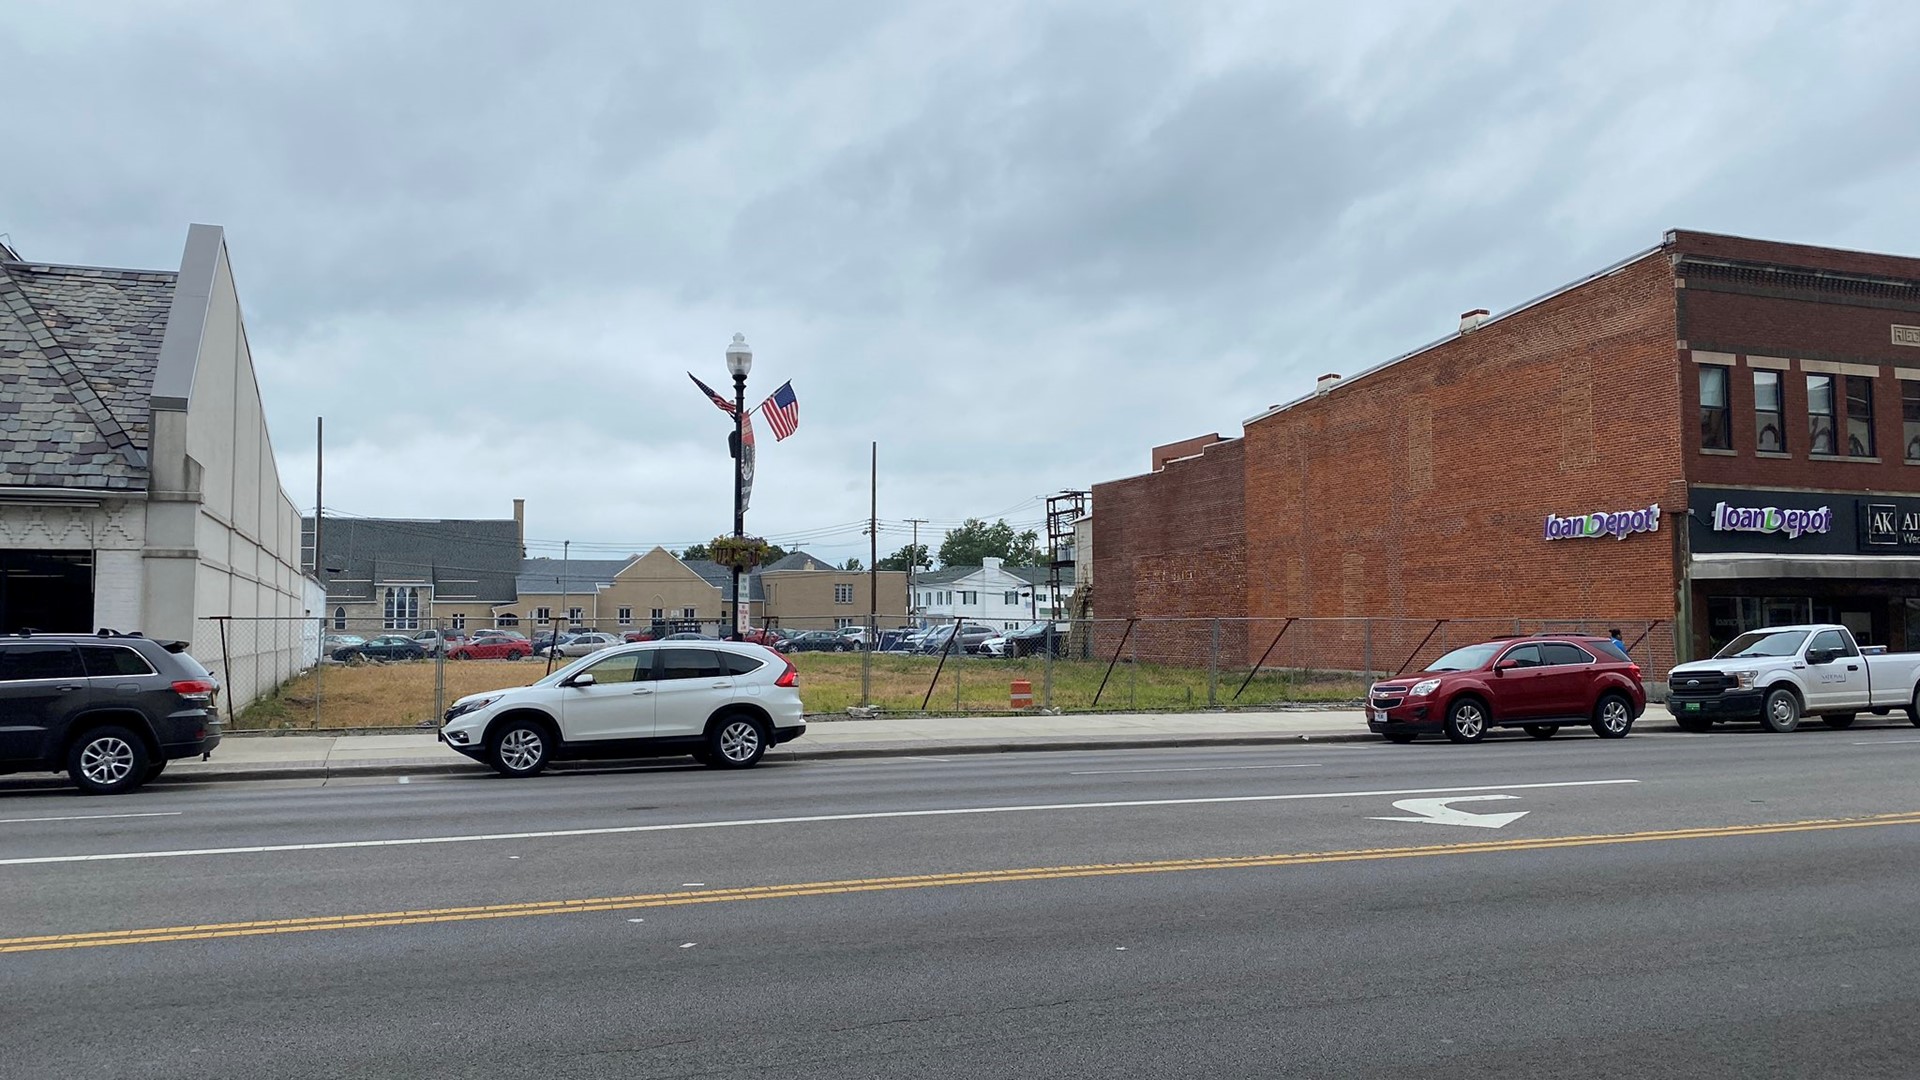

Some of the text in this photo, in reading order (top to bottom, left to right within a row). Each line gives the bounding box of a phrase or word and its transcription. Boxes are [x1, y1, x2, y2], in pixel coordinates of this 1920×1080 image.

[1544, 504, 1658, 539] loanDepot
[1718, 503, 1832, 538] loanDepot
[1871, 512, 1896, 535] AK
